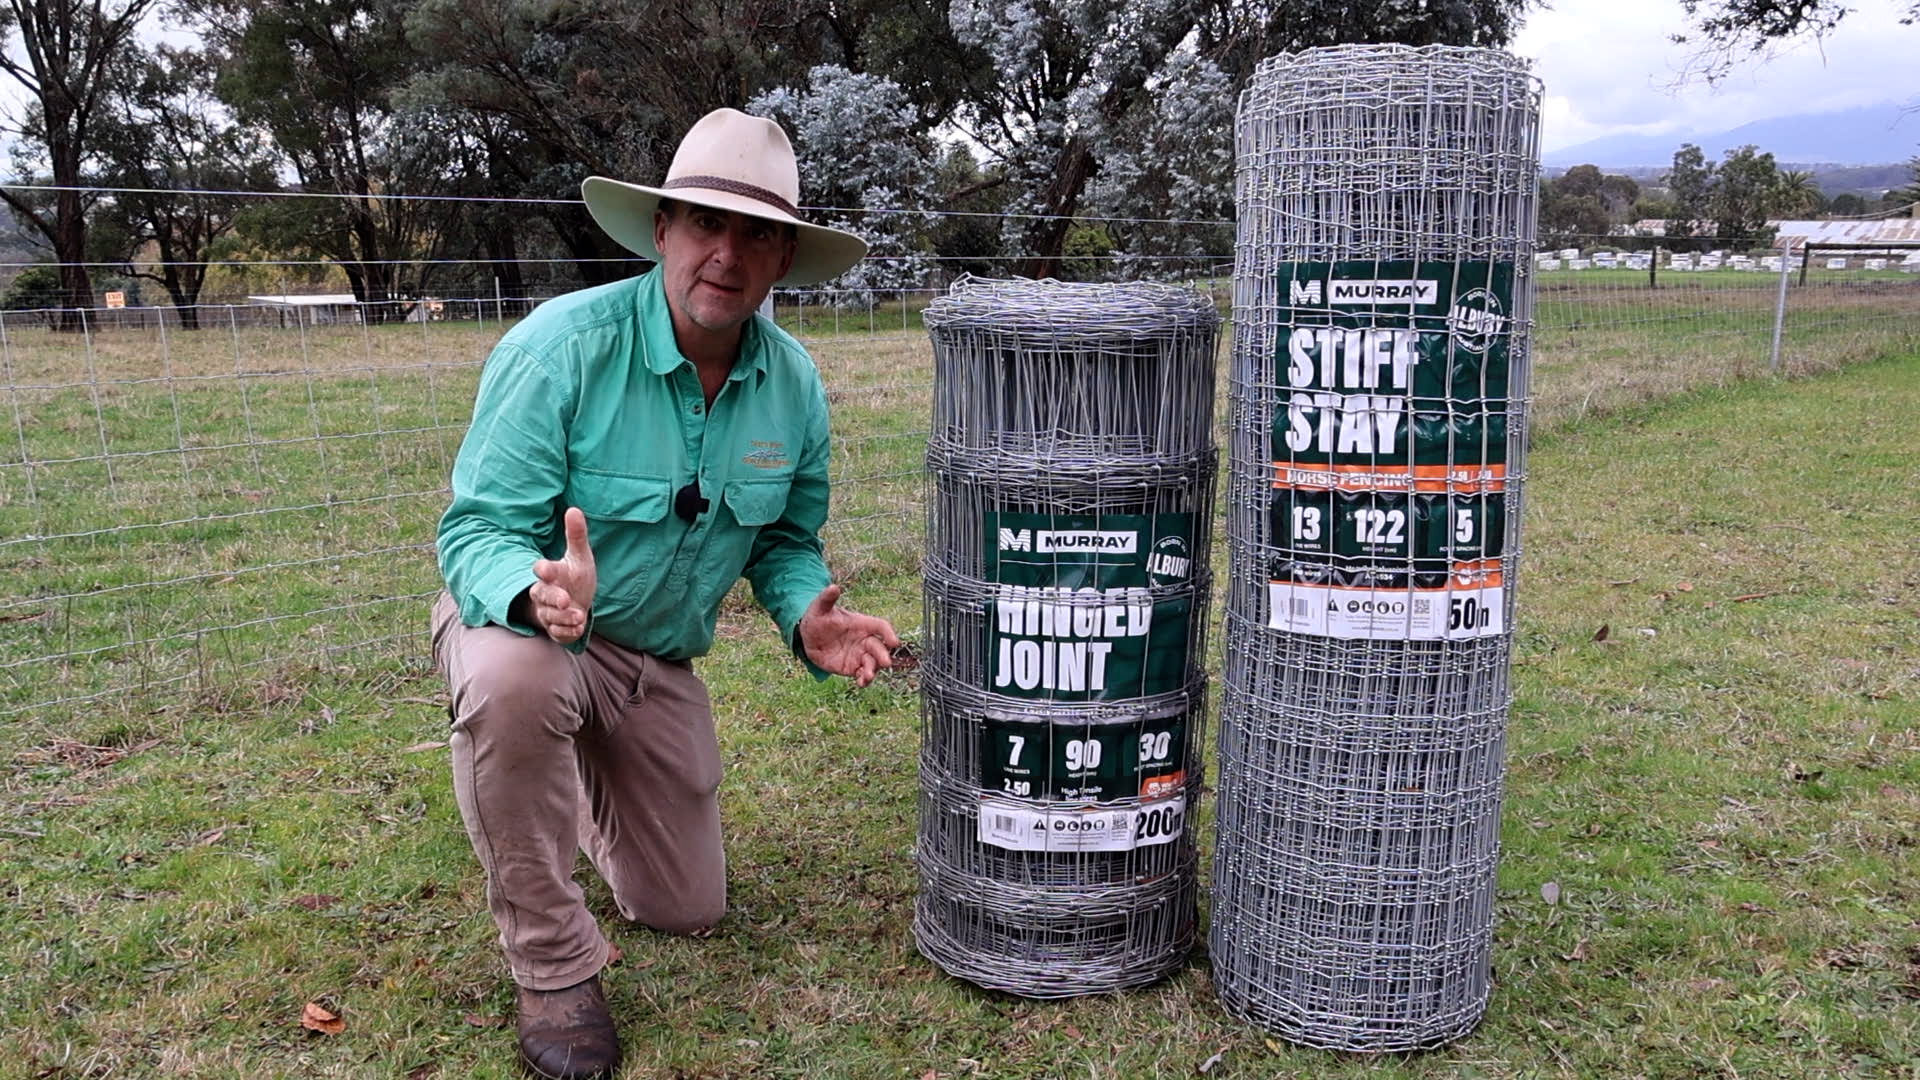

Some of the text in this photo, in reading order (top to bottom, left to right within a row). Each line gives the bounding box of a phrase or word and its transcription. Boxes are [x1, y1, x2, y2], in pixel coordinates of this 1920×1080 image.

[1335, 285, 1429, 298] MURRAY
[1288, 328, 1419, 389] STIFF
[1285, 393, 1402, 454] STAY
[1286, 468, 1411, 487] HORSE FENCING
[1293, 506, 1321, 541] 13
[1354, 509, 1405, 543] 122
[1455, 509, 1473, 543] 5
[1045, 536, 1130, 548] MURRAY
[997, 584, 1153, 637] HINGED
[1450, 597, 1489, 630] 50m
[995, 638, 1112, 691] JOINT
[1009, 735, 1025, 766] 7
[1065, 739, 1101, 771] 90
[1140, 731, 1171, 762] 30
[1004, 778, 1031, 796] 2.50
